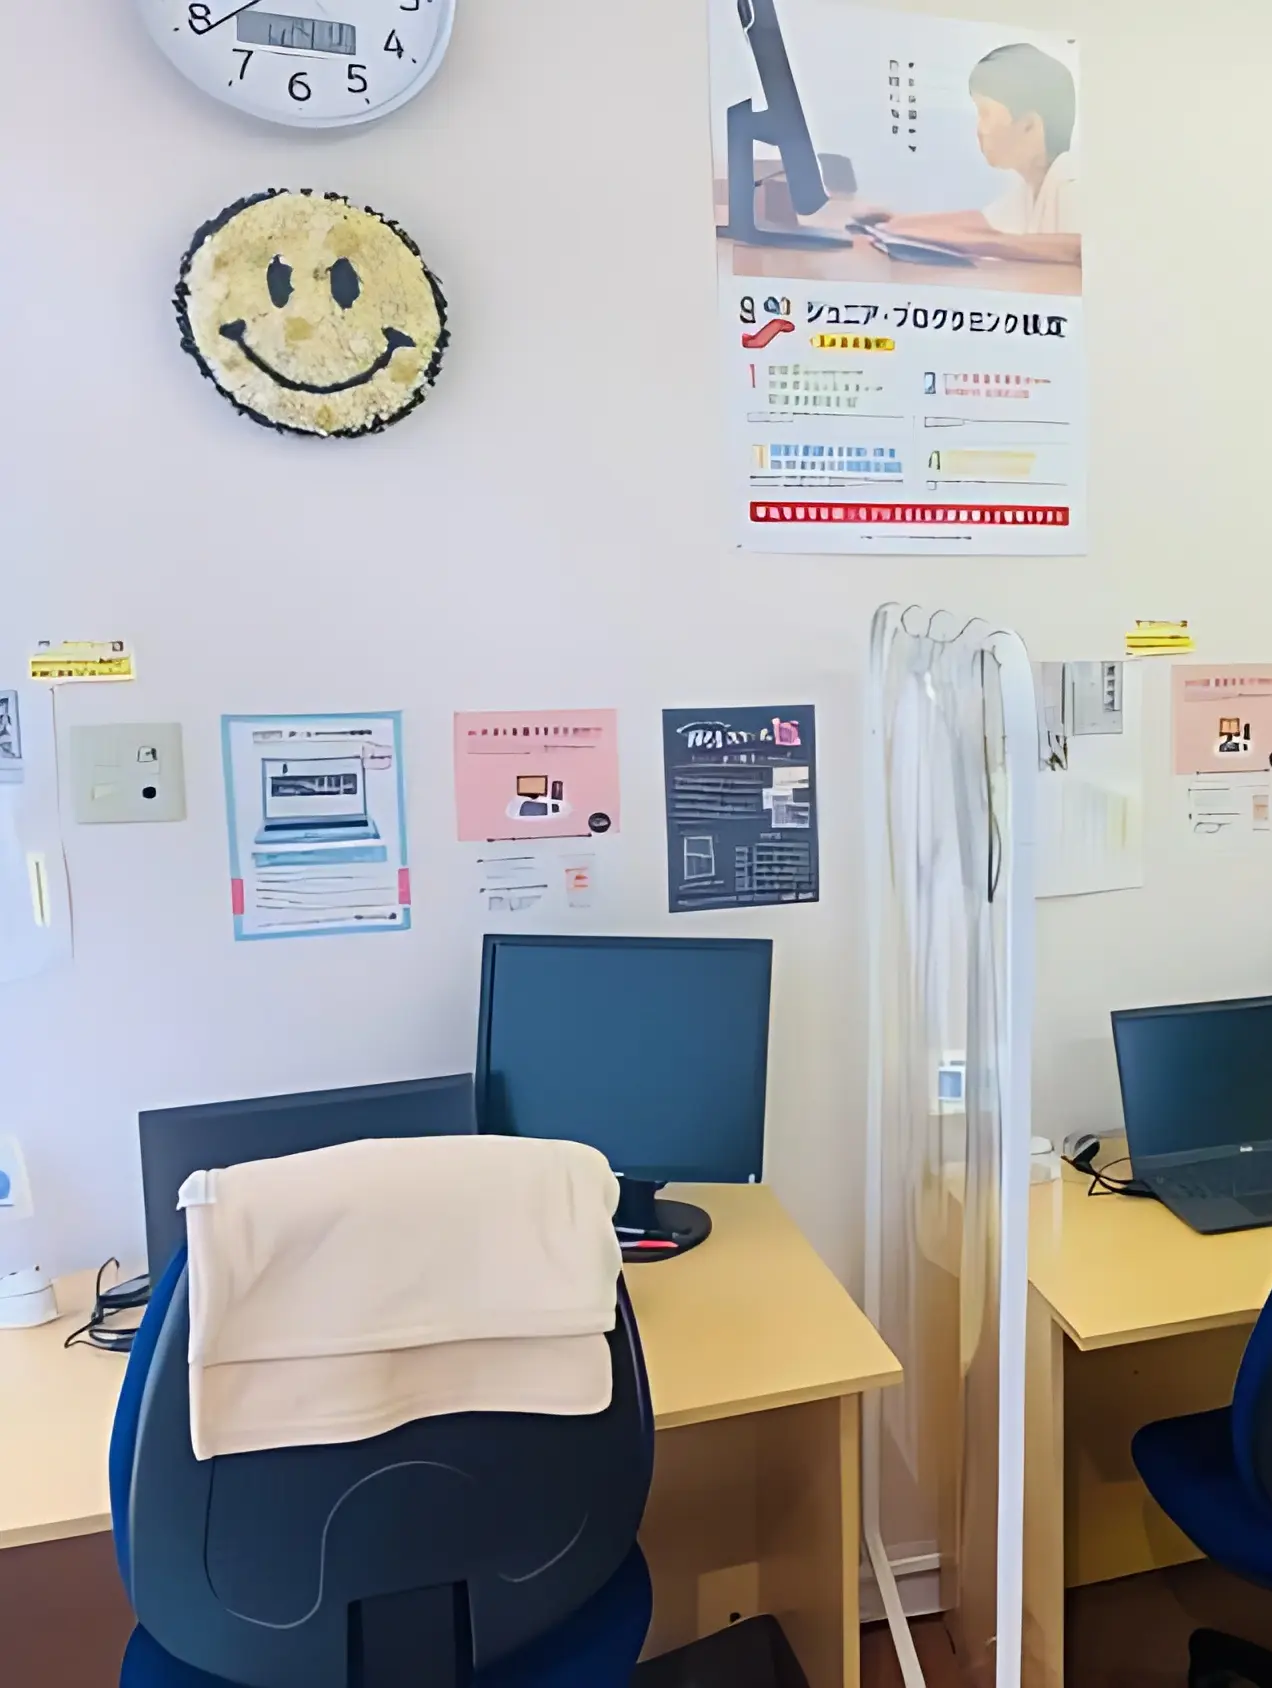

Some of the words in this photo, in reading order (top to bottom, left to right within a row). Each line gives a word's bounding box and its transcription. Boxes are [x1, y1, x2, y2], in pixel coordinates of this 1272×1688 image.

[383, 29, 405, 59] 4
[232, 48, 254, 80] 7
[346, 64, 369, 94] 5
[287, 72, 312, 102] 6
